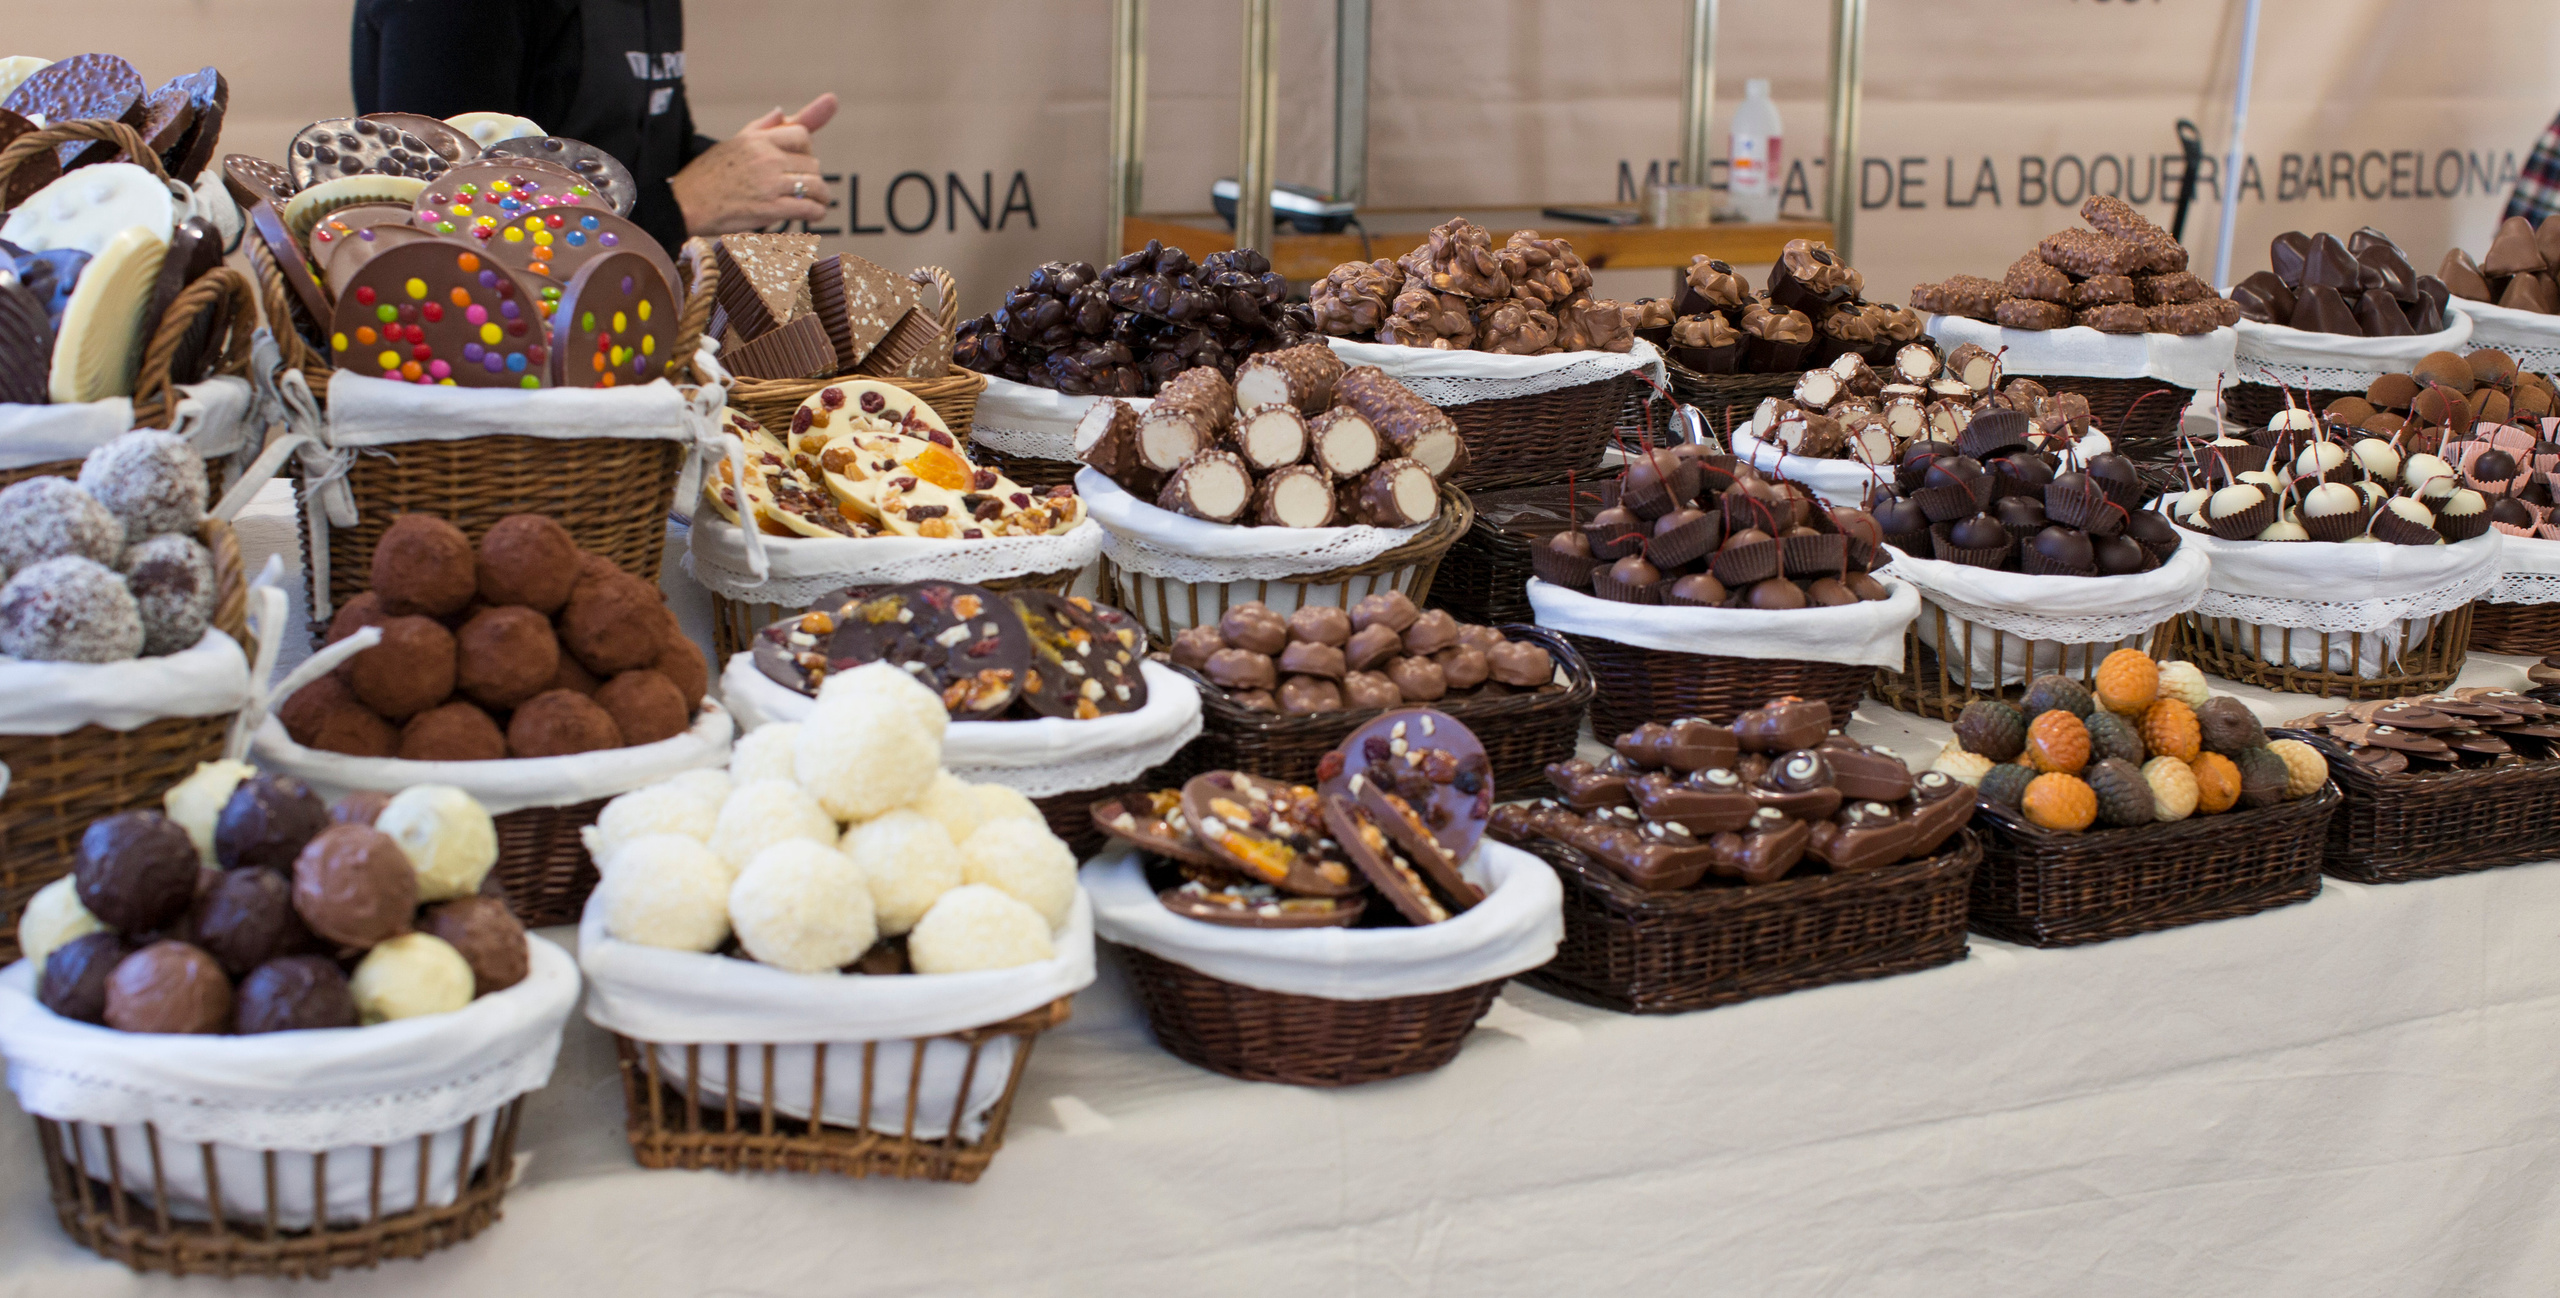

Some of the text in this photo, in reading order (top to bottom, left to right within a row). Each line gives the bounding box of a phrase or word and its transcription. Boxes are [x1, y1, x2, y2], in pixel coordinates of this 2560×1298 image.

[1861, 157, 1926, 210] DE
[1945, 156, 2001, 208] LA
[2278, 149, 2518, 202] BARCELONA
